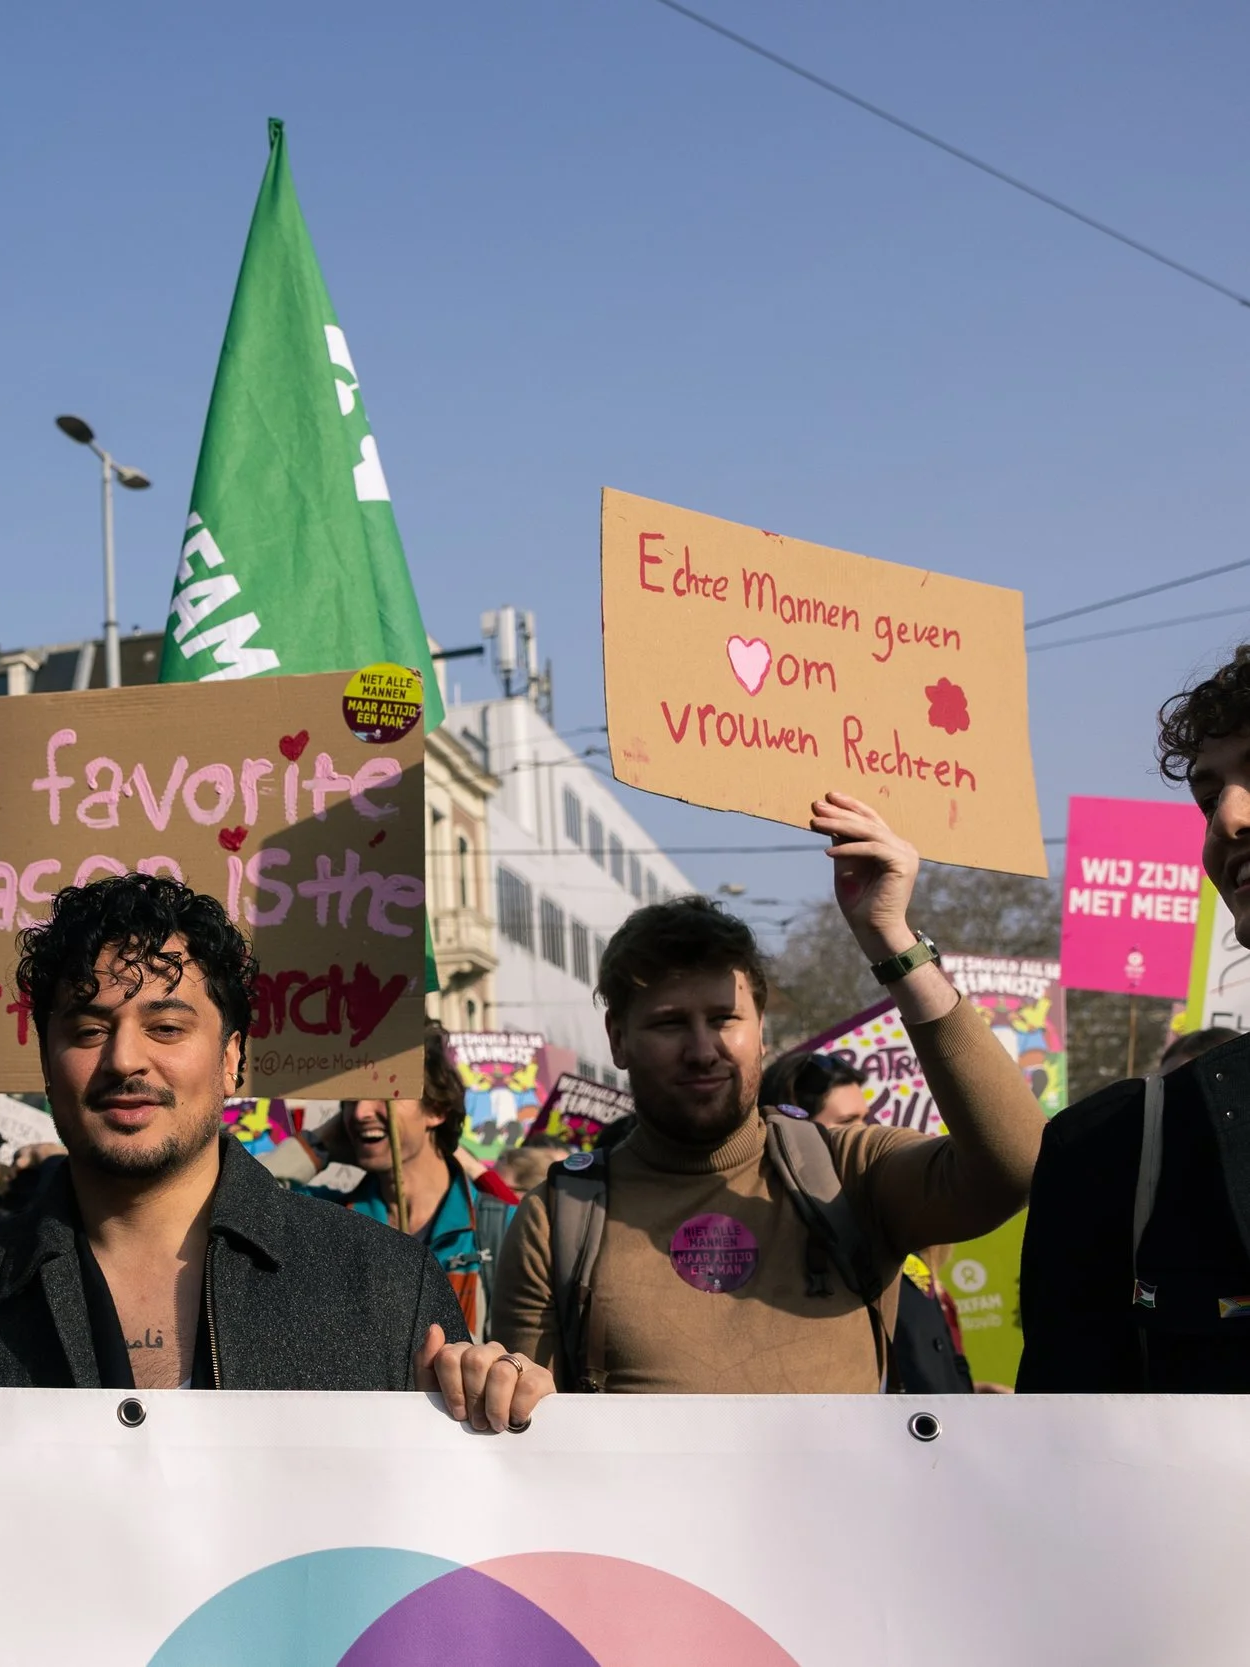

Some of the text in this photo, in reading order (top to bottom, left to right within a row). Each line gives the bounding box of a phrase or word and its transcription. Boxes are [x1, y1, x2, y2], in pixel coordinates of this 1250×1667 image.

[639, 532, 729, 602] Echte
[871, 615, 961, 662] geven
[360, 673, 413, 689] NIET ALLE
[776, 653, 836, 692] om
[362, 686, 406, 699] MANNEN
[347, 700, 416, 718] MAAR ALTIJD
[356, 712, 378, 724] EEN
[843, 715, 976, 792] Rechten
[32, 729, 403, 831] favorite
[1081, 856, 1199, 892] WIJ ZIJN
[298, 848, 425, 937] the
[1068, 887, 1127, 918] MET
[941, 954, 964, 973] WE
[965, 955, 1019, 976] SHOULD
[1020, 960, 1043, 979] ALL
[952, 972, 1050, 999] FEMINISTS
[464, 1032, 508, 1047] SHOULD
[455, 1046, 536, 1066] FEMINISTS
[684, 1225, 741, 1238] NIET ALLE
[689, 1236, 738, 1248] MANNEN
[677, 1252, 711, 1264] MAAR
[691, 1264, 742, 1276] EEN MAN
